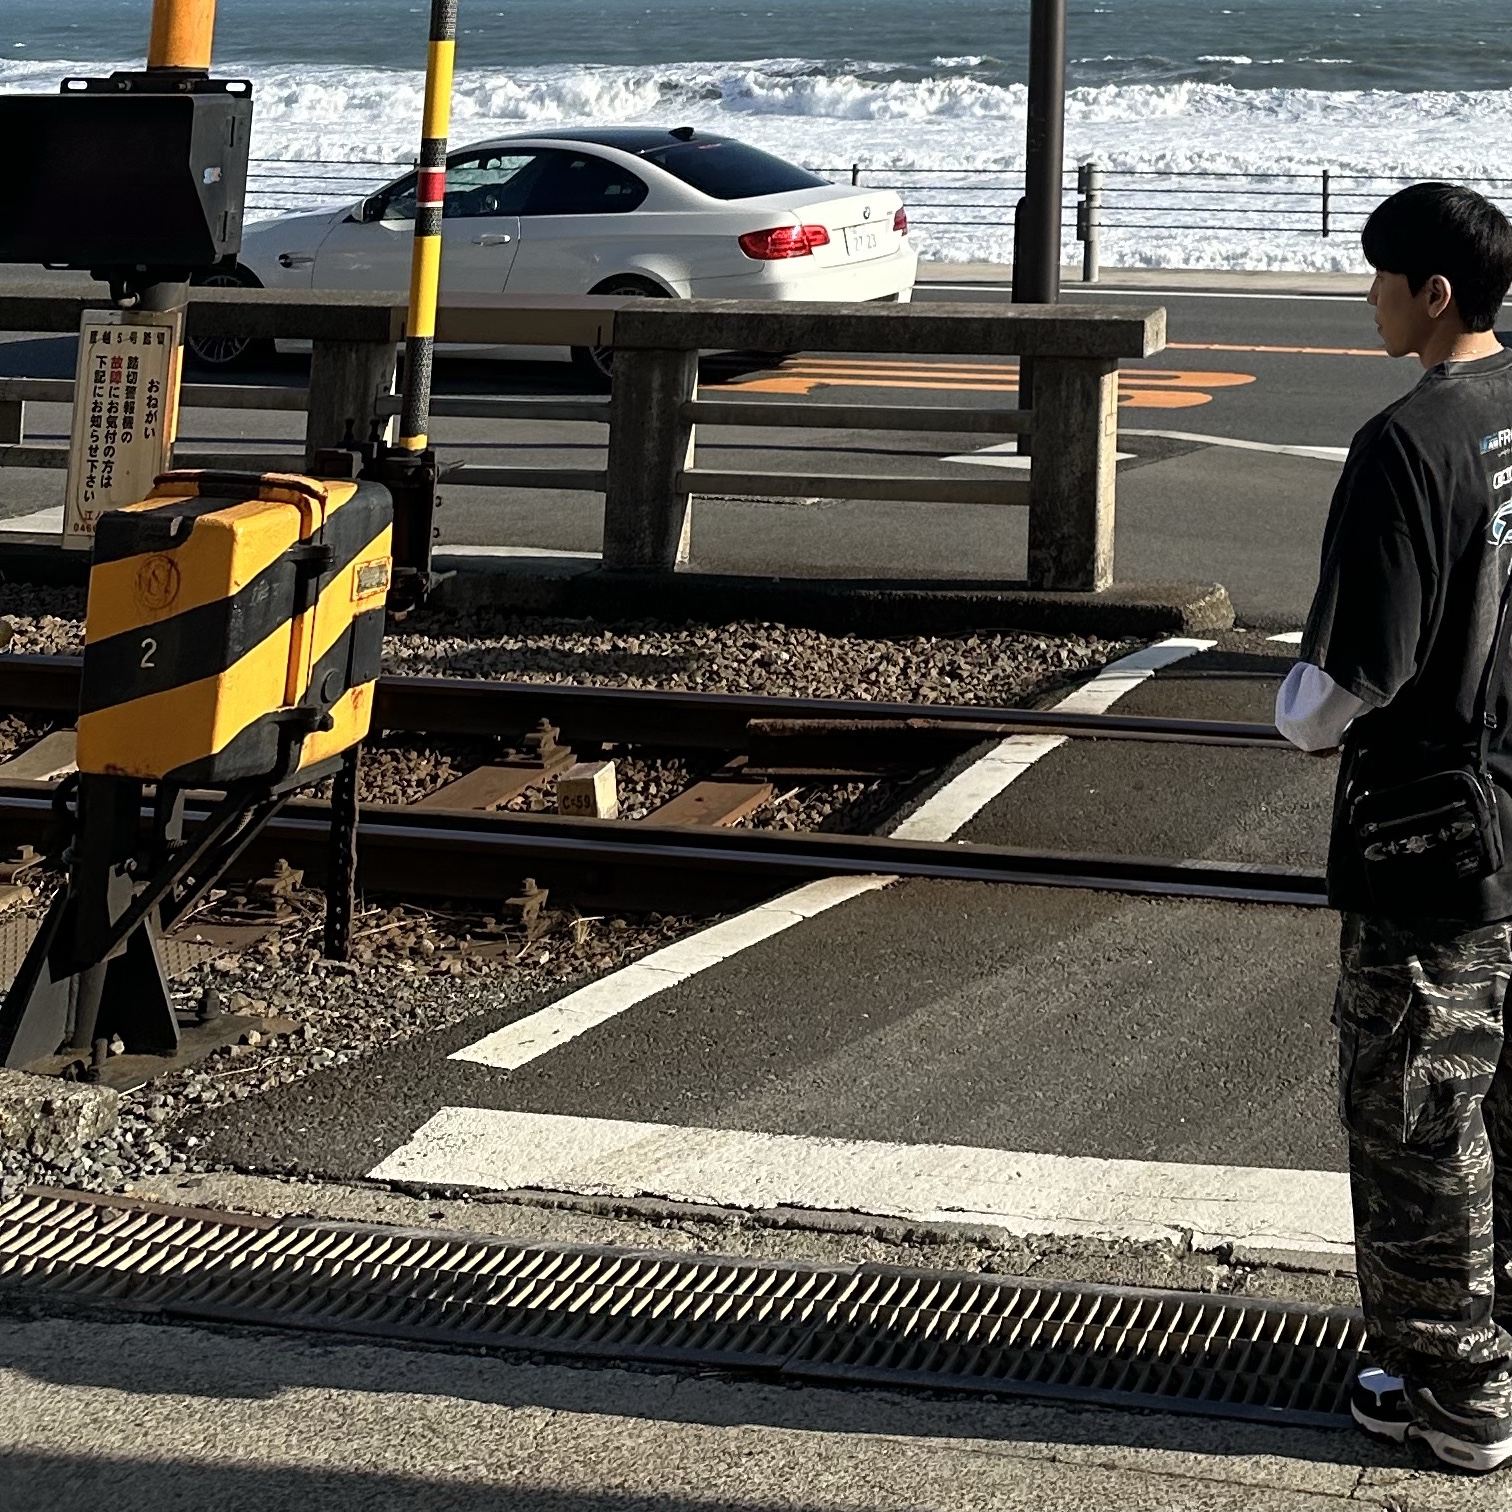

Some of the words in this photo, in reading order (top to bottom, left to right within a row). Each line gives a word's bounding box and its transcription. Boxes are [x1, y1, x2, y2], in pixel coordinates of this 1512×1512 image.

[83, 355, 108, 503] 下記にお知らせ下さい
[143, 378, 161, 440] おねがい
[140, 638, 158, 668] 2
